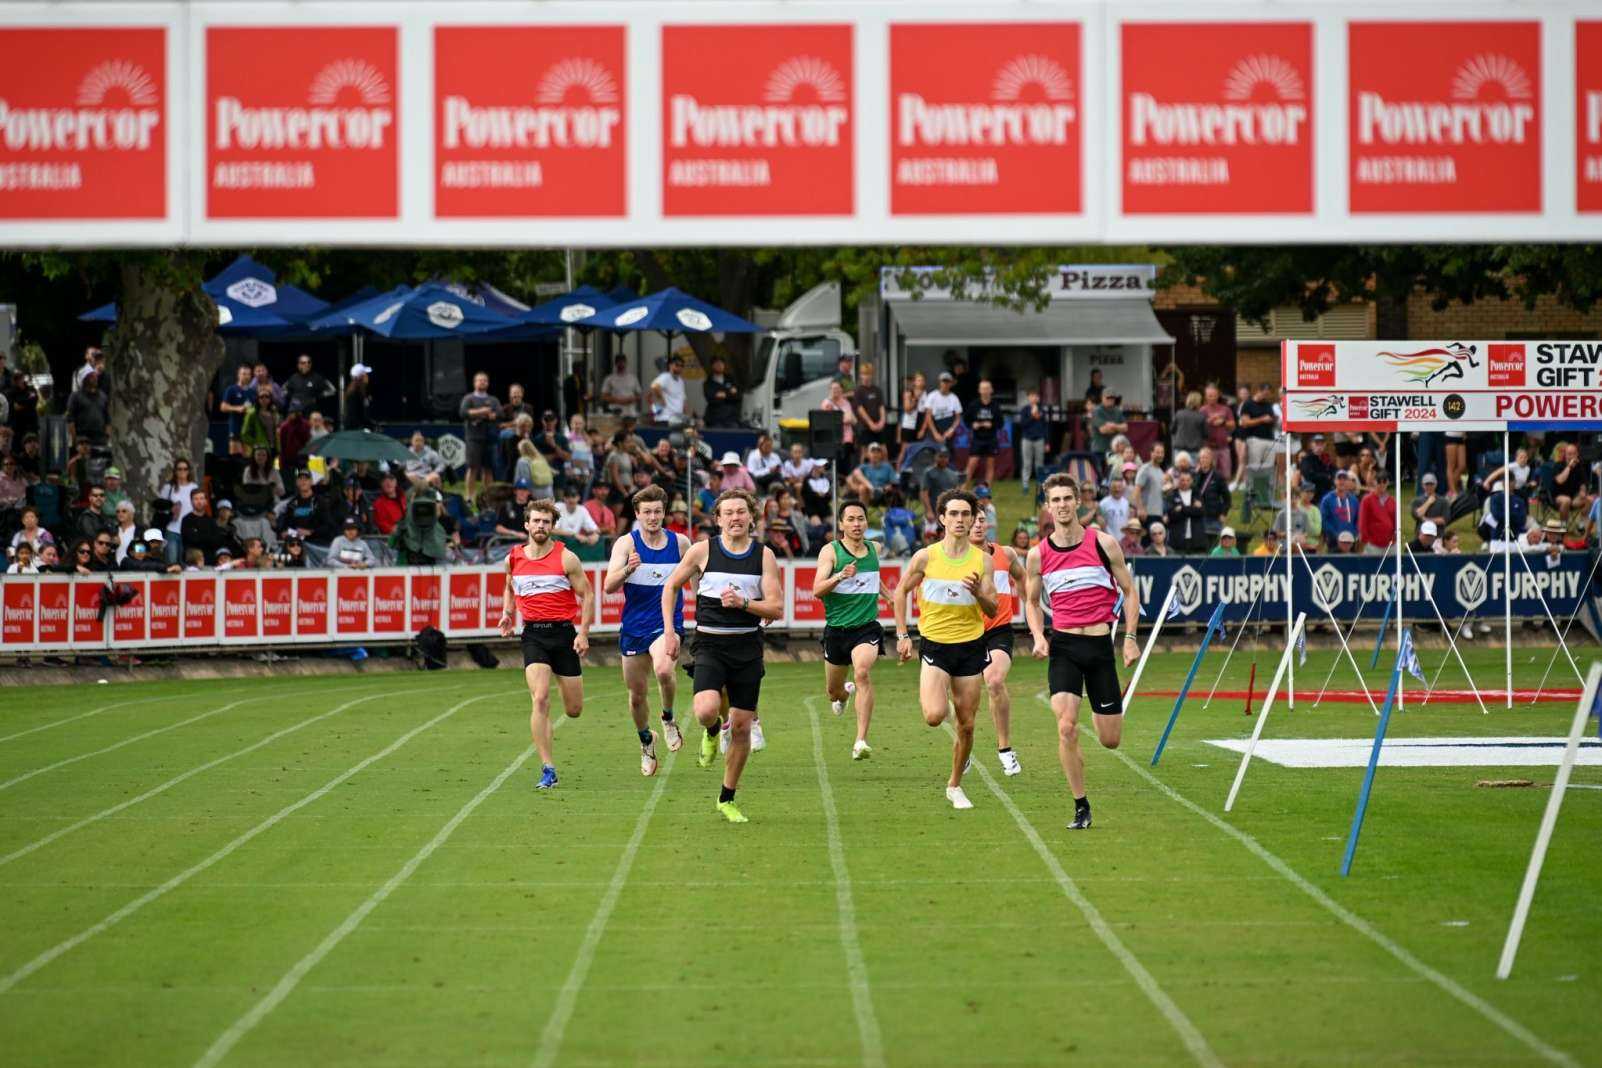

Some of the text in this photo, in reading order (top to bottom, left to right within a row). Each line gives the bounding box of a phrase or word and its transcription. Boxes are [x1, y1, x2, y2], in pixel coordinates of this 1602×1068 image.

[216, 97, 392, 149] Powercor
[443, 96, 620, 149] Powercor
[671, 94, 848, 147] Powercor
[899, 93, 1076, 146] Powercor
[1130, 92, 1307, 145] Powercor
[1359, 92, 1533, 144] Powercor
[214, 162, 315, 188] AUSTRALIA
[441, 161, 543, 188] AUSTRALIA
[668, 159, 771, 187] AUSTRALIA
[897, 158, 999, 186] AUSTRALIA
[1129, 157, 1230, 184] AUSTRALIA
[1357, 157, 1457, 183] AUSTRALIA
[1061, 271, 1142, 290] Pizza
[1537, 367, 1595, 387] GIFT
[1370, 395, 1437, 407] STAWELL
[1370, 408, 1402, 419] GIFT
[1404, 408, 1437, 419] 2024
[1496, 394, 1602, 418] POWER
[1206, 574, 1294, 604] FURPHY
[1347, 573, 1436, 603] FURPHY
[1491, 571, 1580, 600] FURPHY
